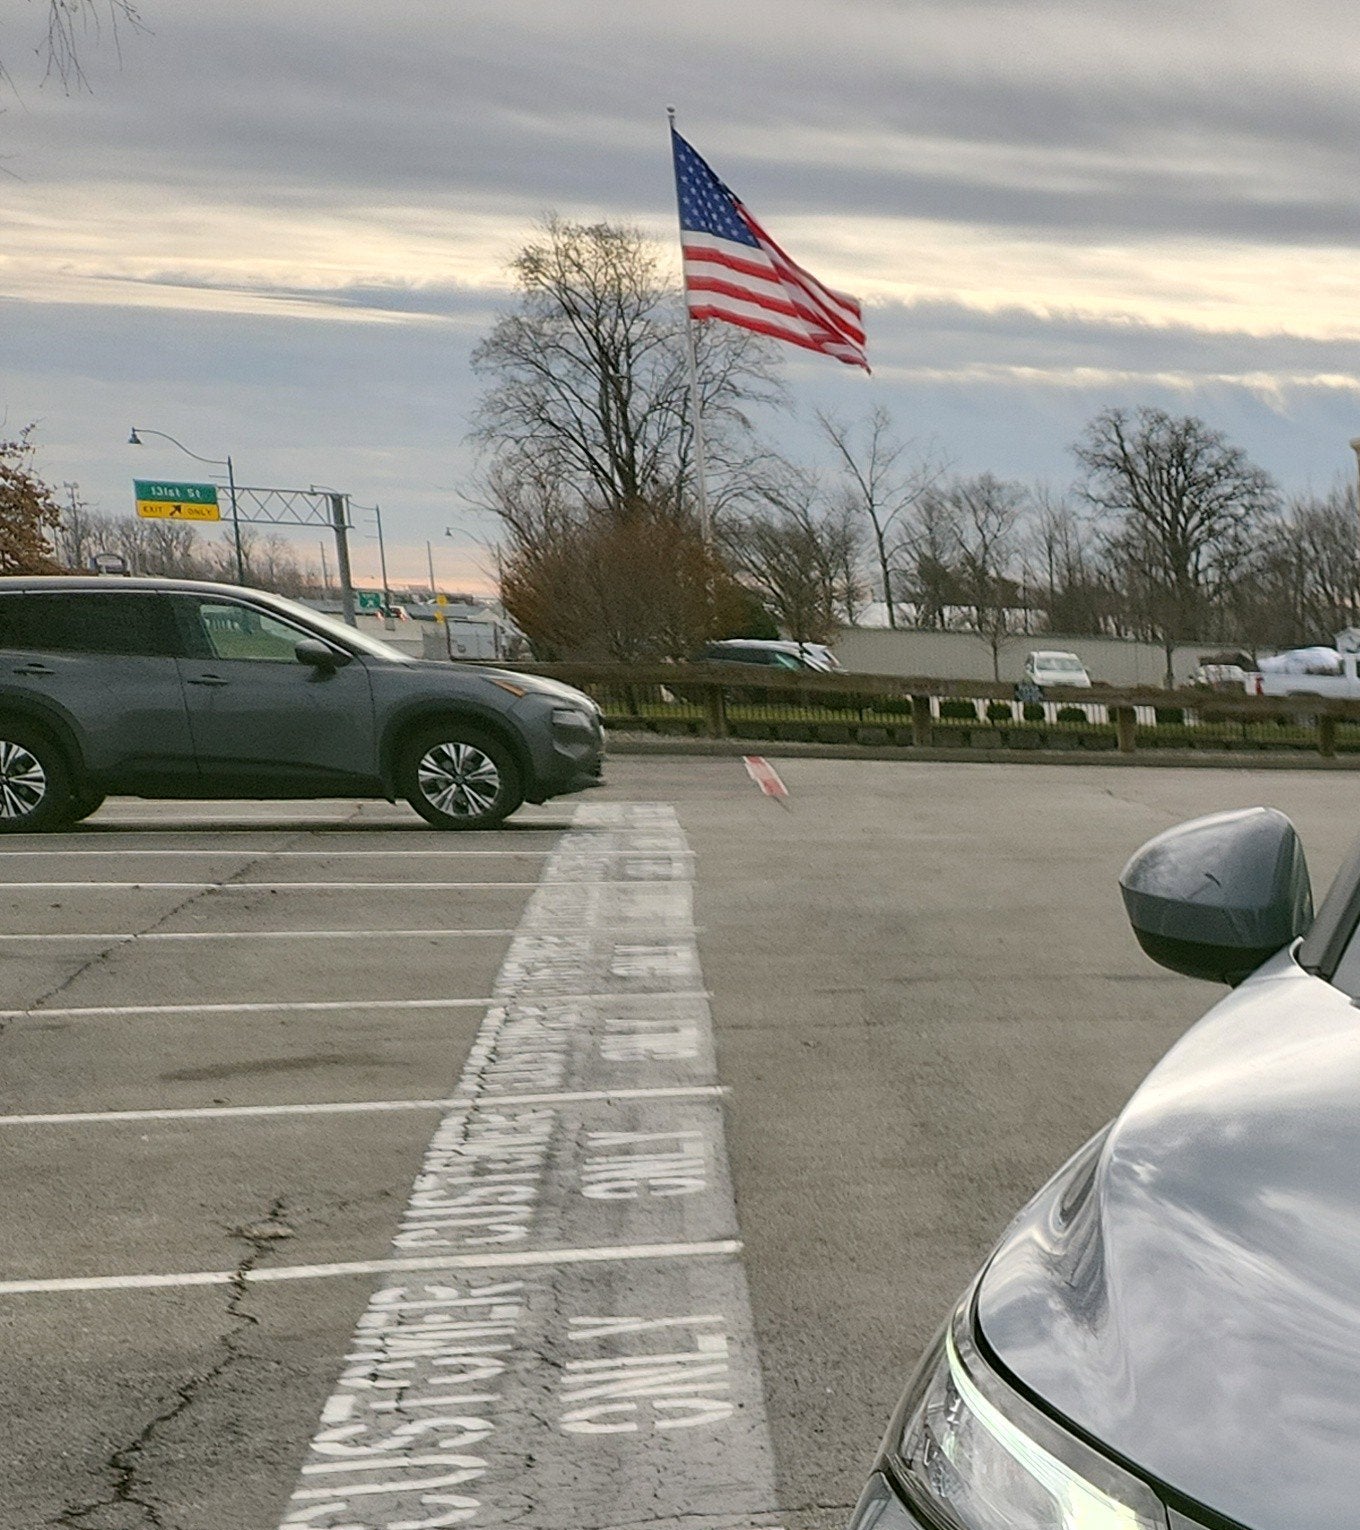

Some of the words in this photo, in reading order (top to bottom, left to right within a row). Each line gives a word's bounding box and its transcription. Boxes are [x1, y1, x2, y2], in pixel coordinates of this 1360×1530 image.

[142, 505, 163, 513] EXIT
[187, 507, 212, 516] ONLY
[150, 485, 181, 498] 131st
[186, 487, 201, 499] St
[580, 1130, 707, 1199] ONLY
[559, 1314, 734, 1435] ONLY
